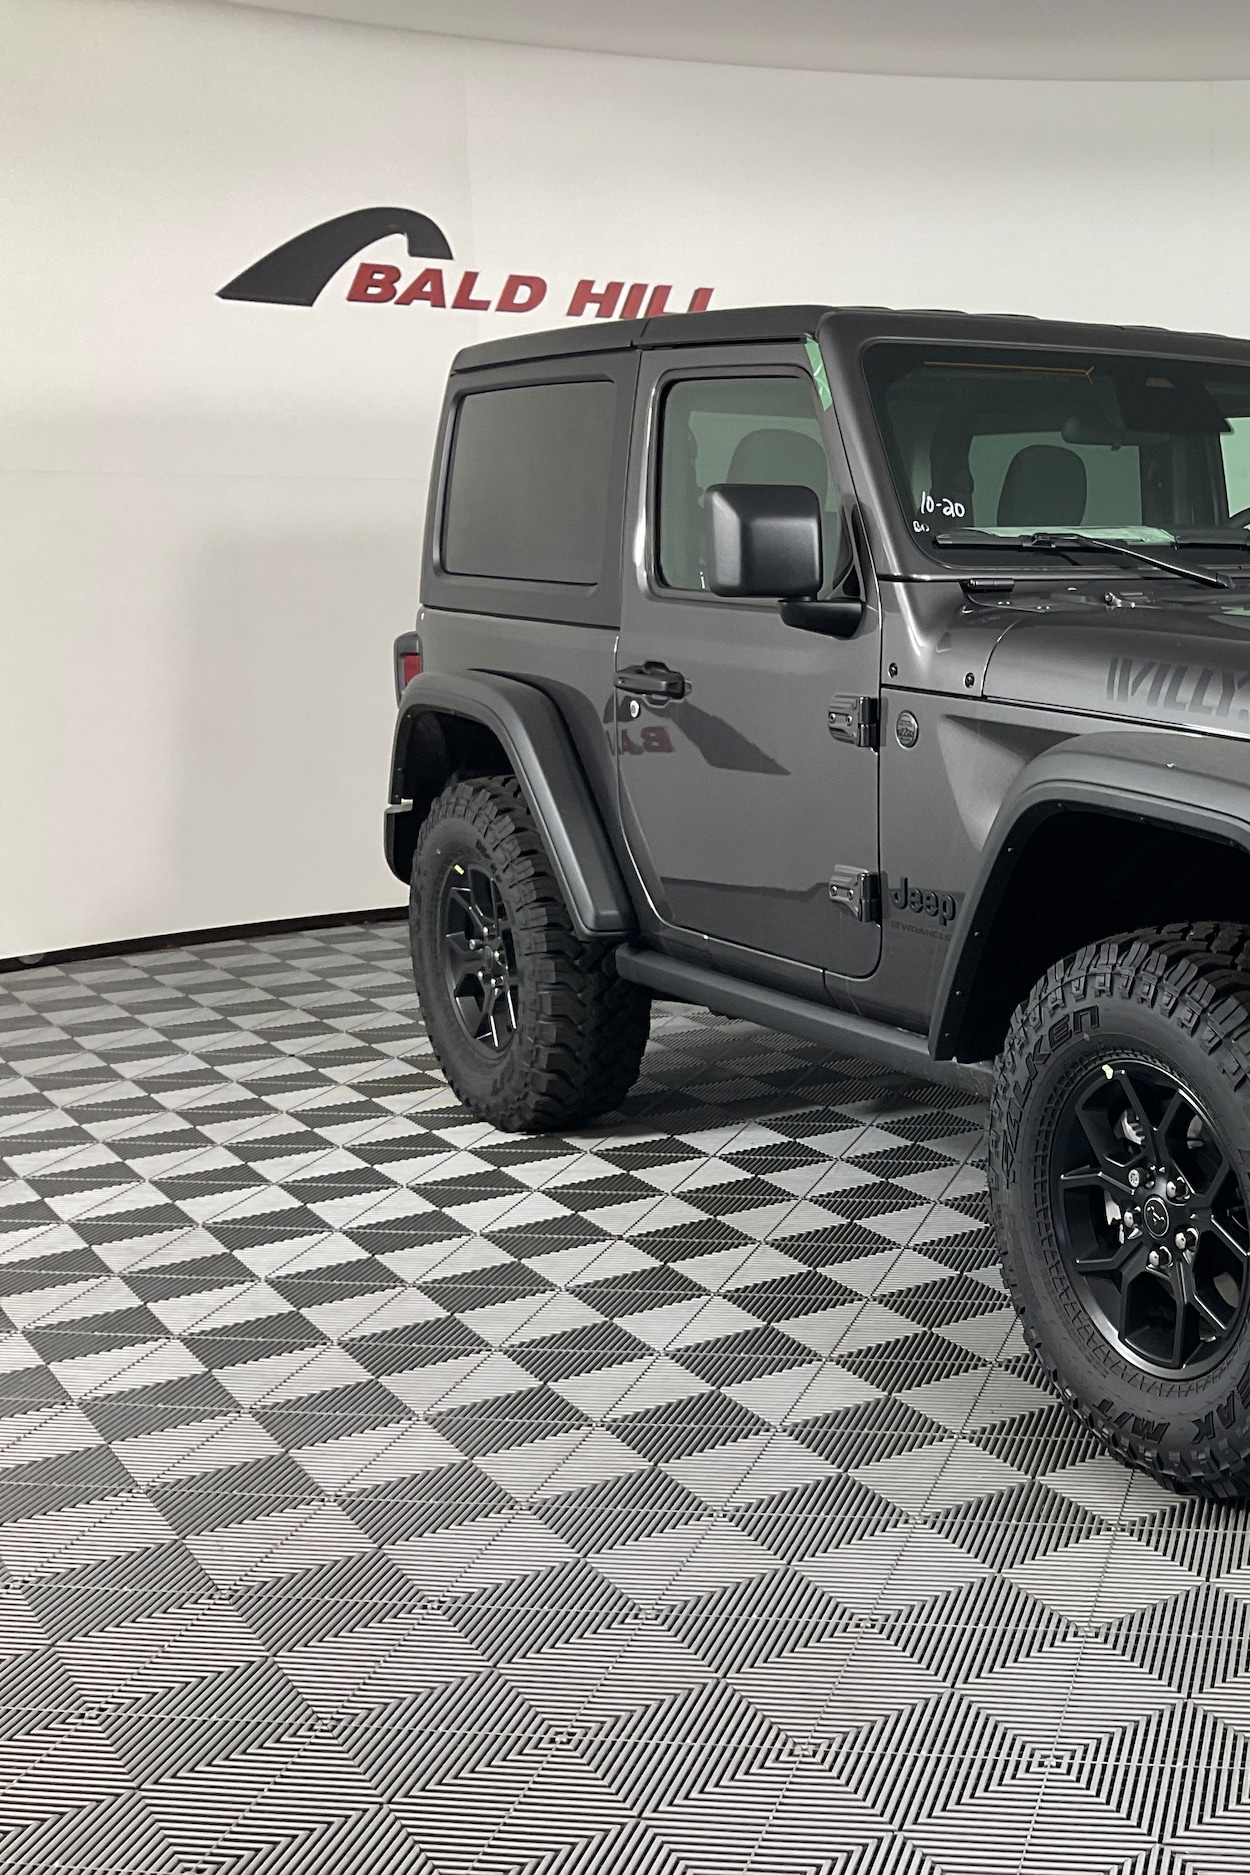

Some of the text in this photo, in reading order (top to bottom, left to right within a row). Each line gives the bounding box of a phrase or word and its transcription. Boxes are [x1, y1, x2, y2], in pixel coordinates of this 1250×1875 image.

[347, 262, 547, 313] BALD
[920, 490, 966, 518] 10-20
[891, 876, 956, 926] Jeep
